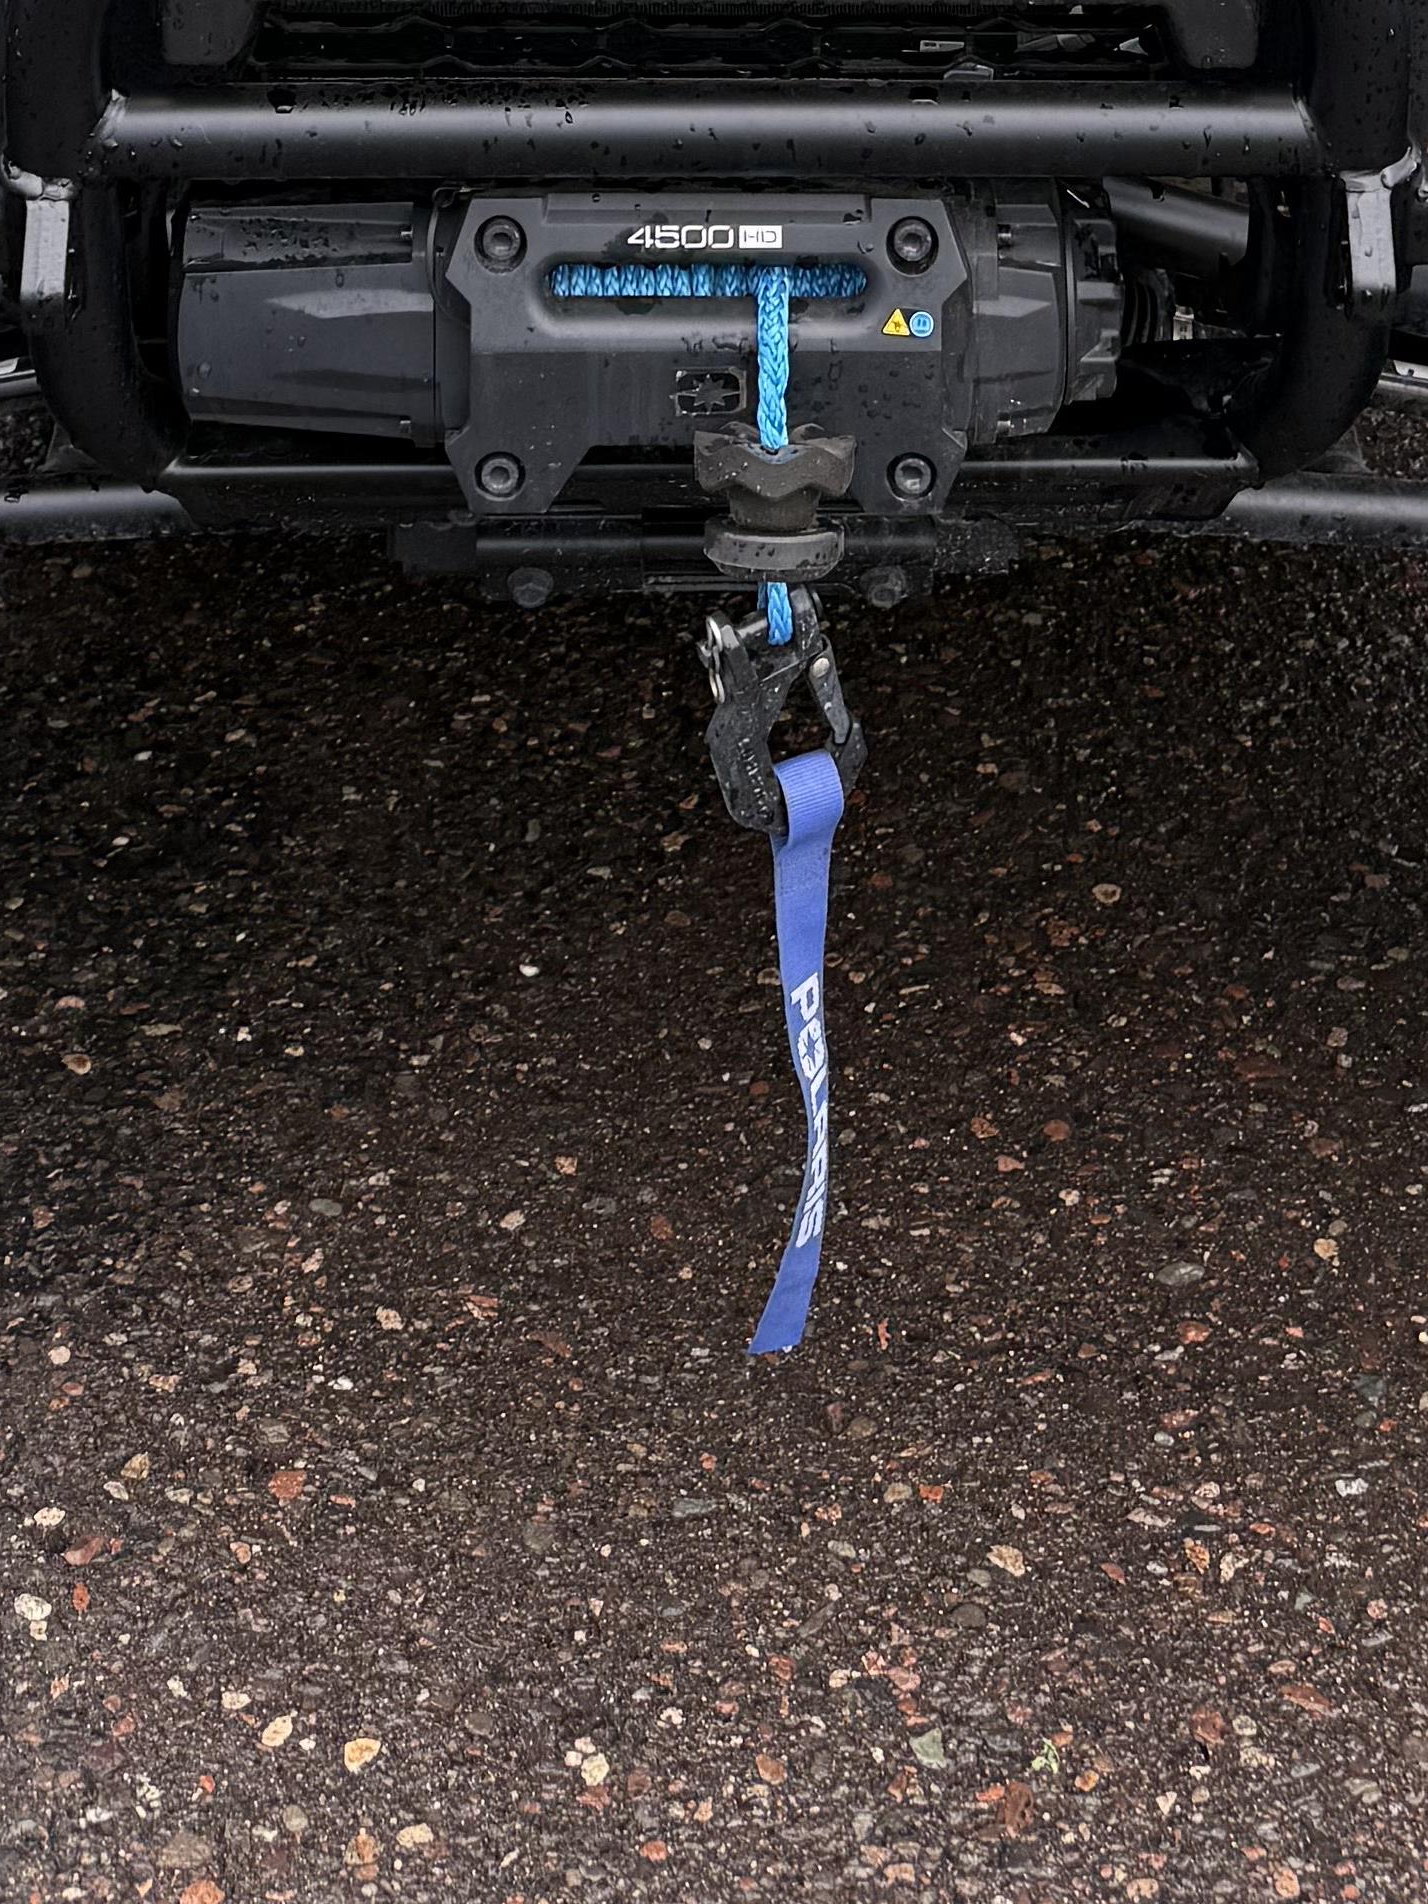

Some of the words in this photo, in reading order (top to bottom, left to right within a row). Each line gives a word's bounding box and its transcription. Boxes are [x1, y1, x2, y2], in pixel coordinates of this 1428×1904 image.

[627, 224, 734, 249] 4500
[742, 228, 779, 245] HD
[790, 972, 829, 1248] POLARIS
